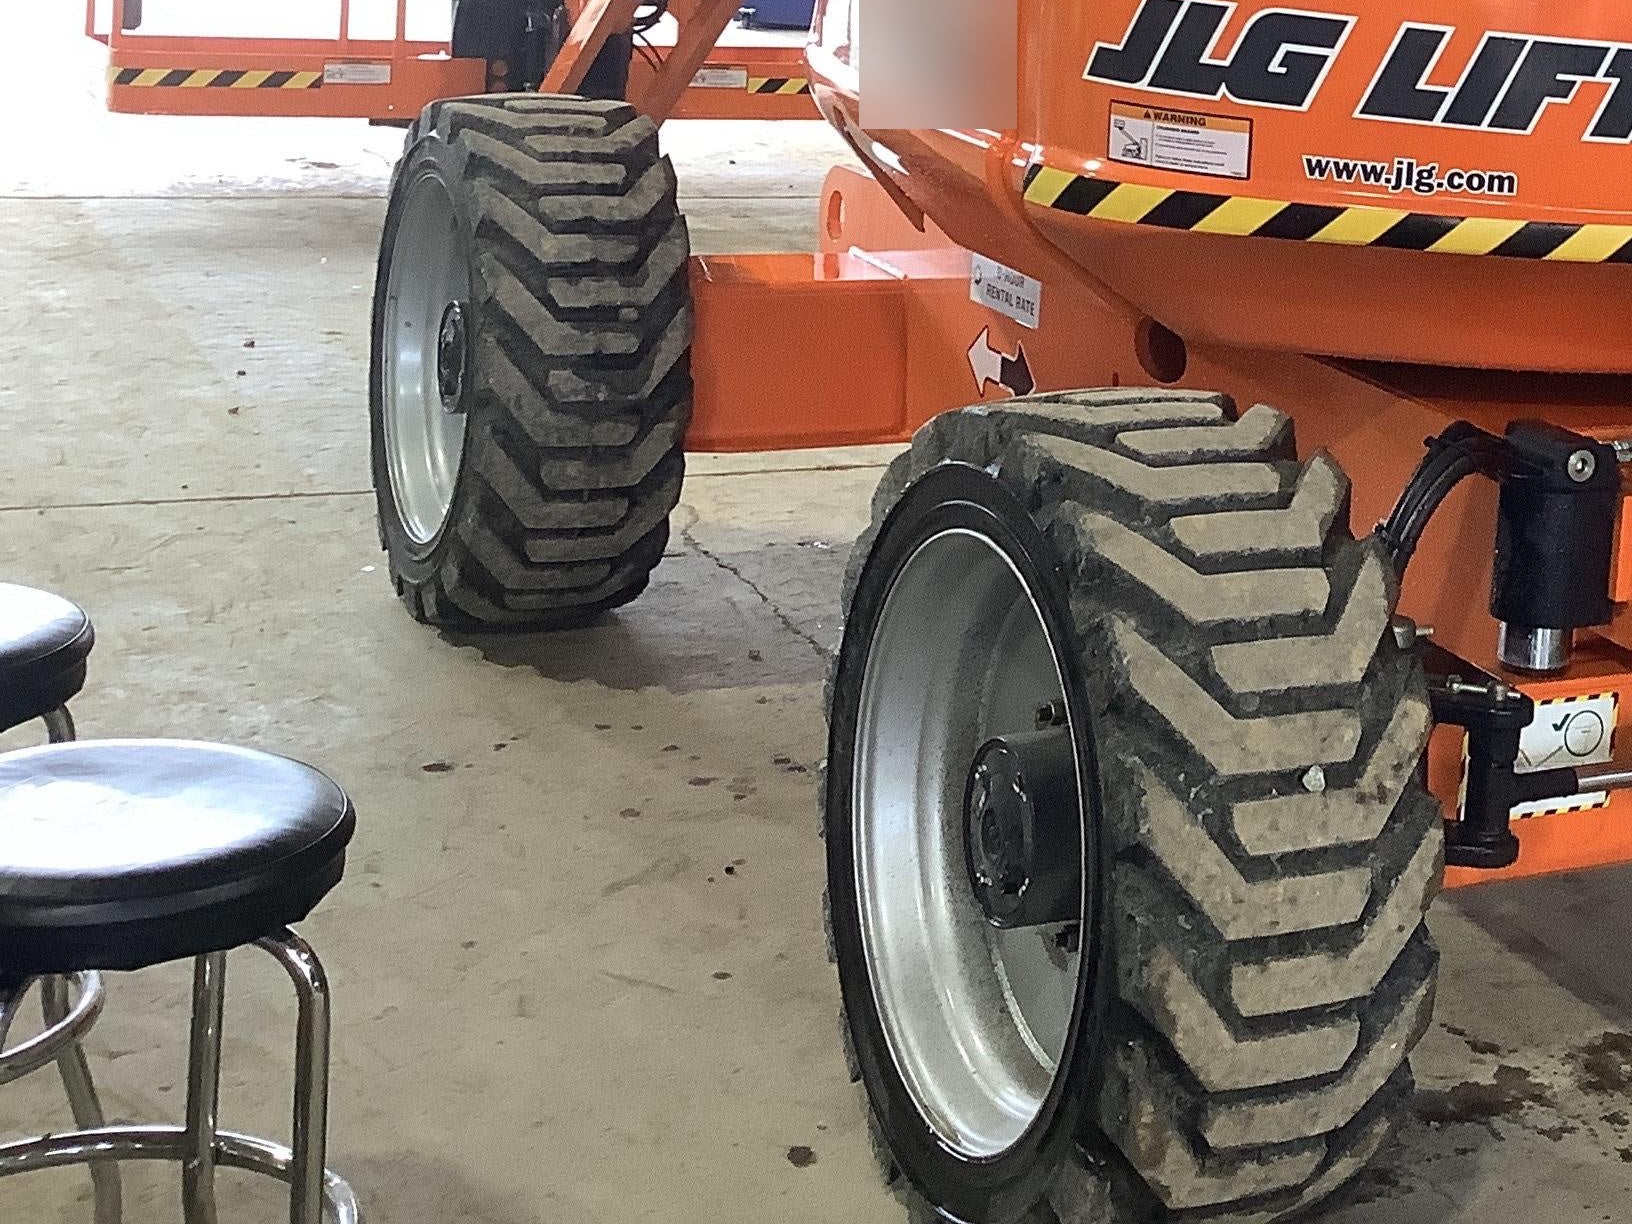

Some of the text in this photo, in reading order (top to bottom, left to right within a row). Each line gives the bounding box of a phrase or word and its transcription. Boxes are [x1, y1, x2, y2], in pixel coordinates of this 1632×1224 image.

[1154, 111, 1206, 126] WARNING
[1304, 157, 1516, 194] www.jlg.com
[986, 283, 1035, 316] RENTAL RATE
